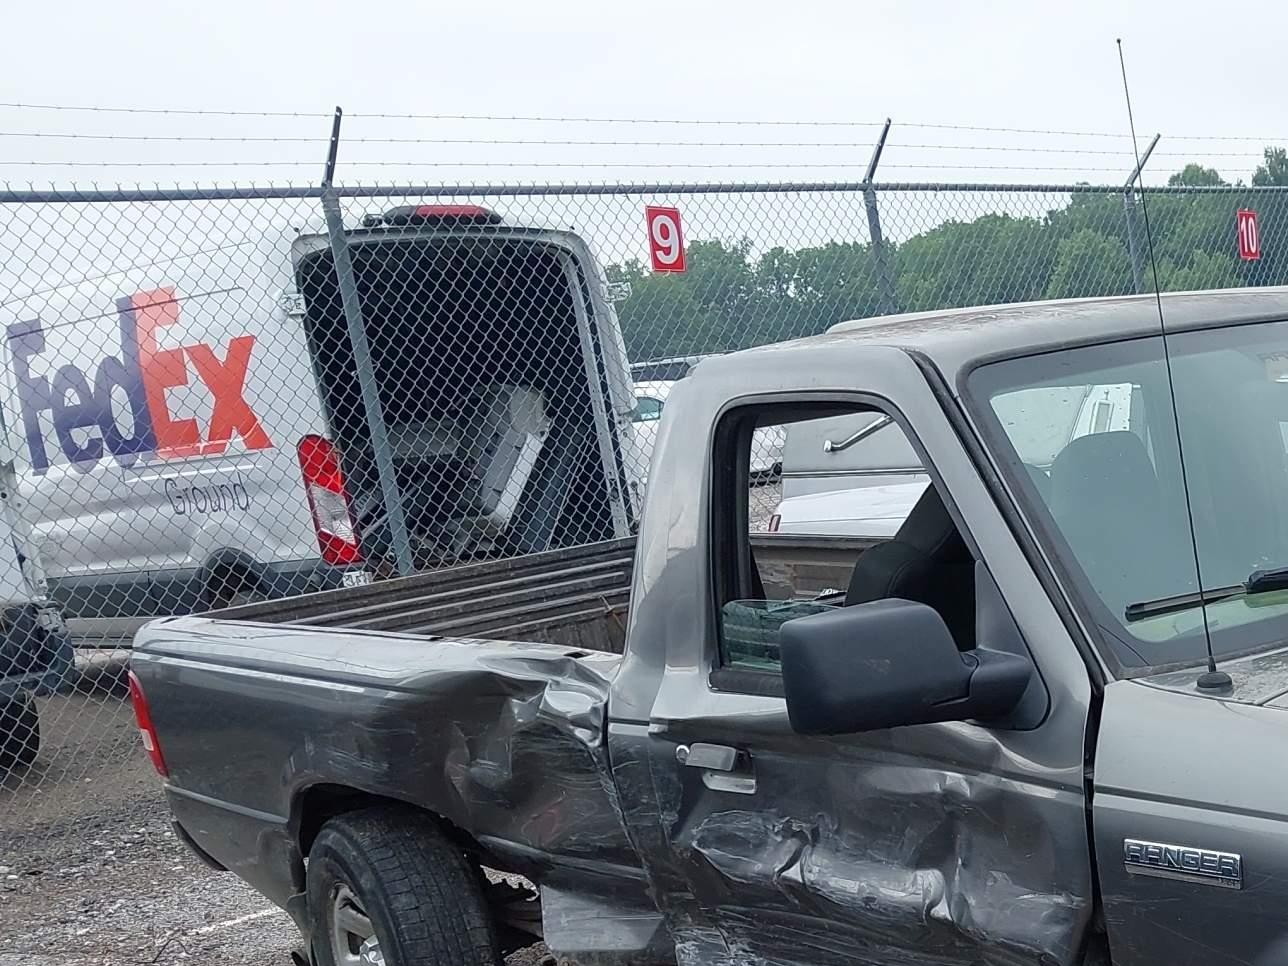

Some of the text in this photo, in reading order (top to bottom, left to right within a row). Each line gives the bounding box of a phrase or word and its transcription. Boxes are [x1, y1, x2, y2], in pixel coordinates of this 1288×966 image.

[652, 214, 680, 264] 9
[1240, 215, 1257, 254] 10
[7, 285, 275, 476] FedEx
[164, 472, 250, 516] Ground
[1125, 842, 1240, 878] RANGER
